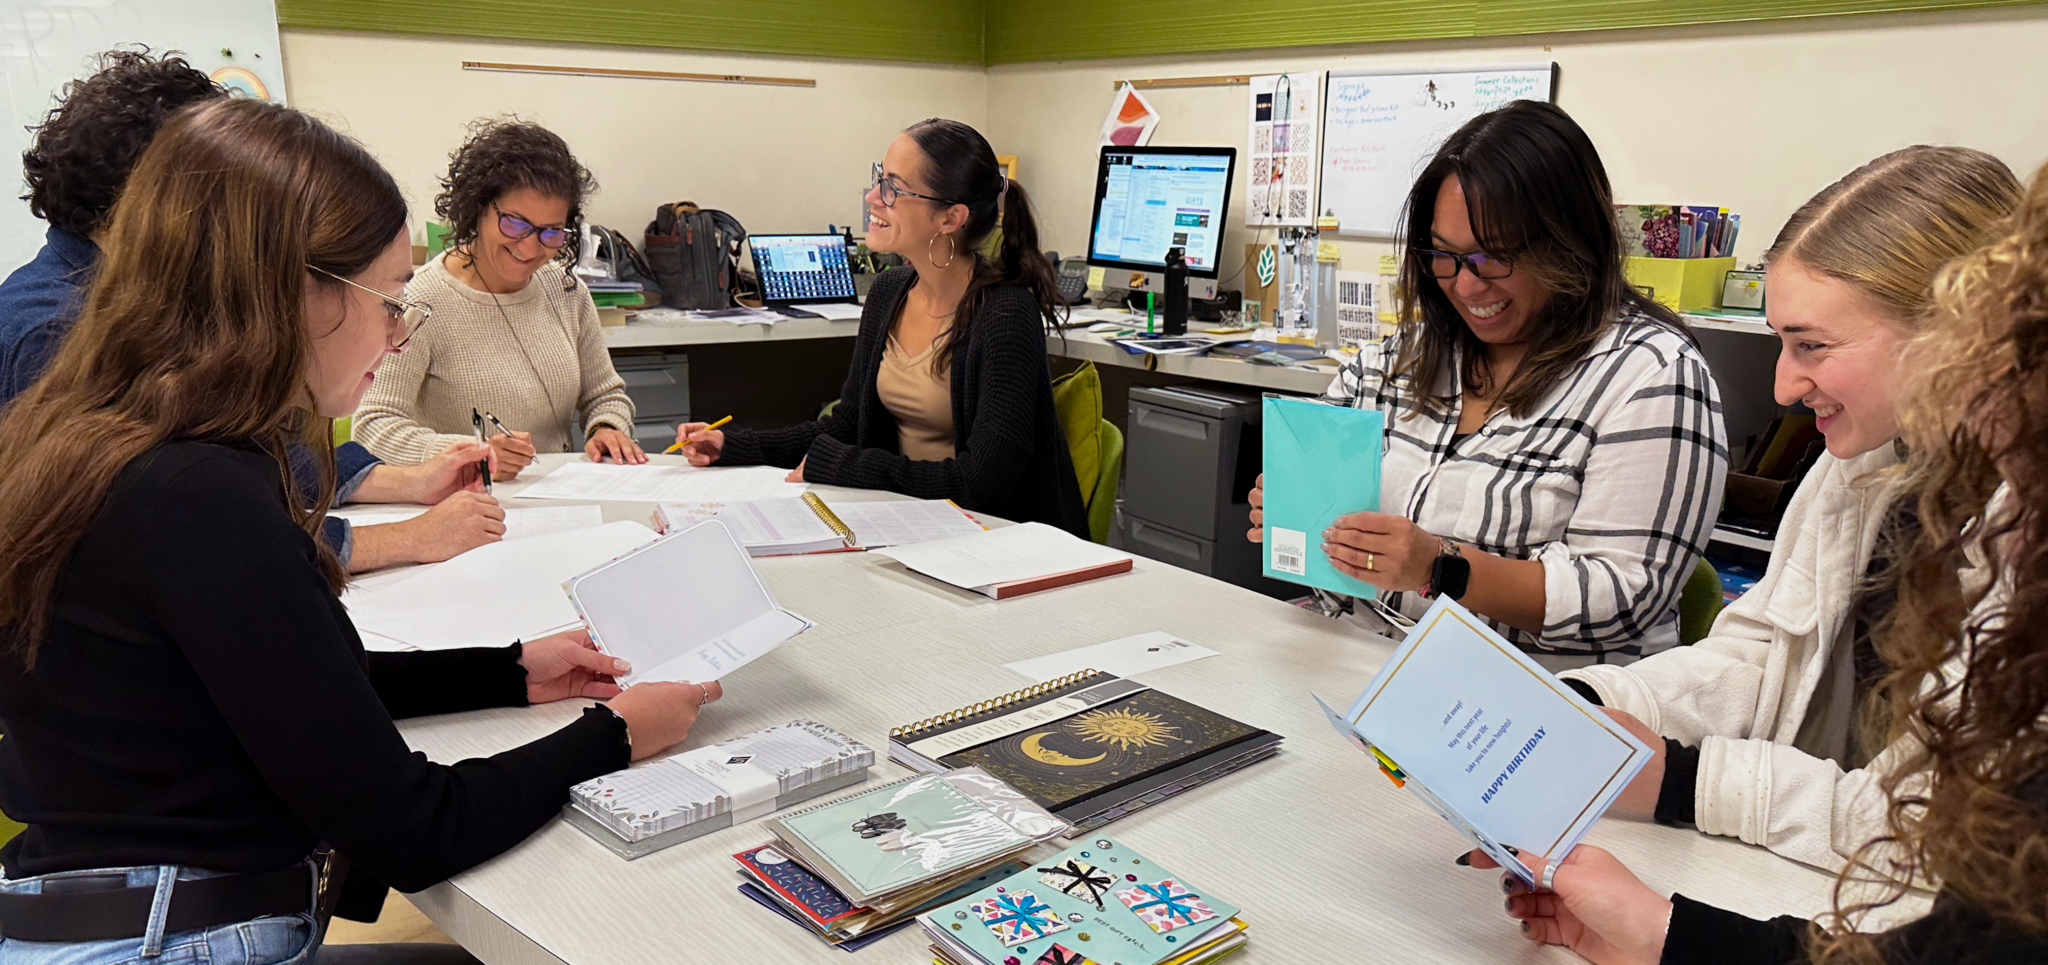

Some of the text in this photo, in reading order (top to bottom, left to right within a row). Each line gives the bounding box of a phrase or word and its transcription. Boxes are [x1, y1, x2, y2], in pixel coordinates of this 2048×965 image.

[1450, 700, 1463, 717] away!
[1447, 708, 1484, 750] May this next year
[1465, 718, 1512, 774] take you to new heights!
[1466, 724, 1489, 751] of your life
[1481, 725, 1546, 804] HAPPY BIRTHDAY
[1093, 917, 1110, 928] BEST
[1109, 926, 1125, 936] GIFT
